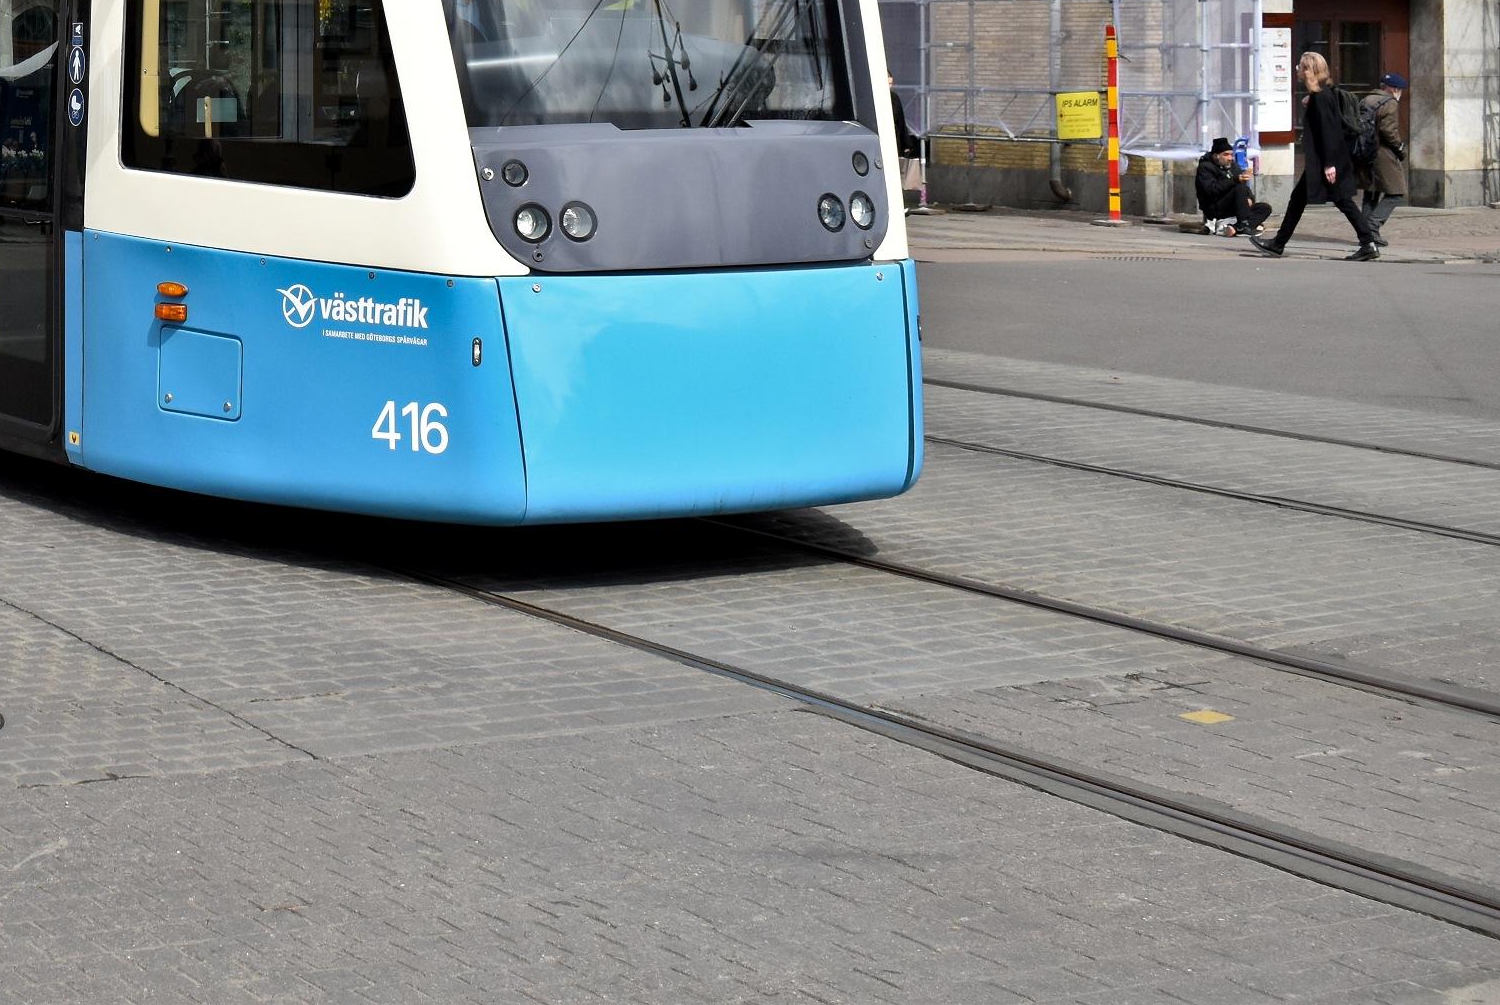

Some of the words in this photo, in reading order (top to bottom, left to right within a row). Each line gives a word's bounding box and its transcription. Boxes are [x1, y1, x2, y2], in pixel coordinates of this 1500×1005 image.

[1074, 98, 1098, 107] ALARM
[319, 291, 429, 329] västtrafik
[325, 329, 354, 339] SAMARBETE
[354, 331, 366, 340] MED
[366, 332, 396, 343] GÖTEBORGS
[370, 399, 449, 455] 416
